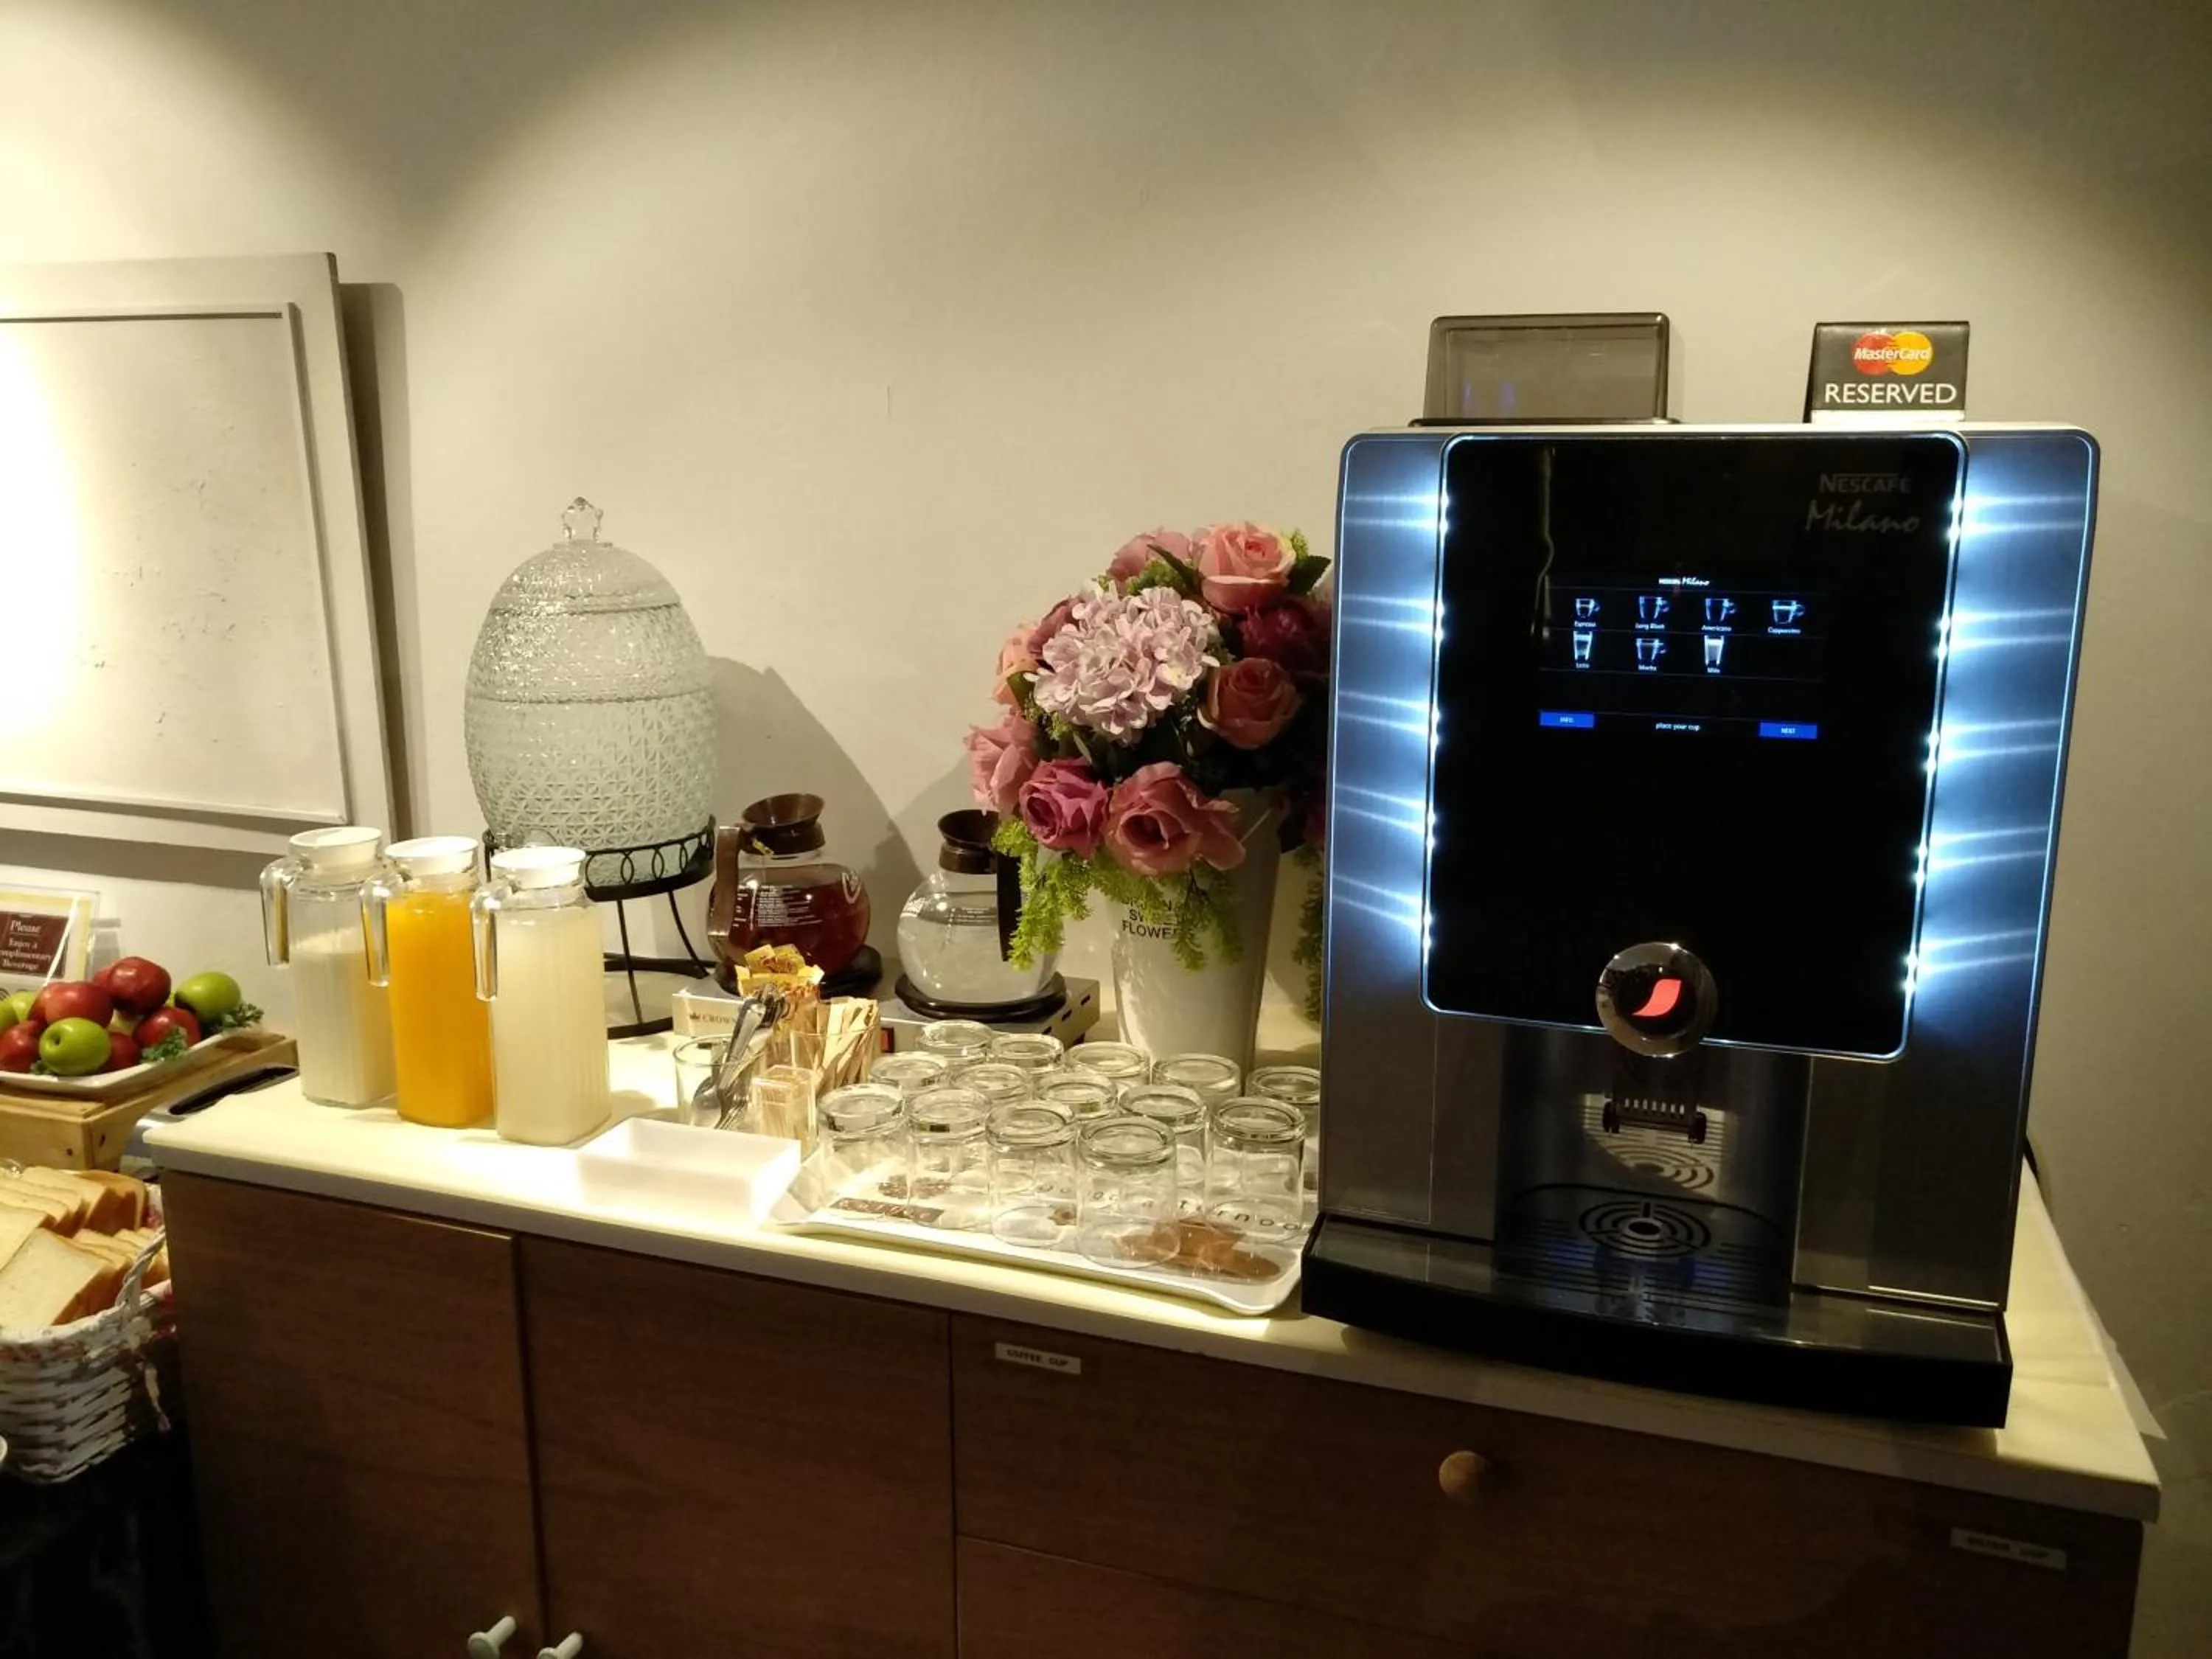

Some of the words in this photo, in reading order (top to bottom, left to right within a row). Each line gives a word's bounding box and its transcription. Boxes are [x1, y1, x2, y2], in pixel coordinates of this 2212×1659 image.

[1854, 347, 1932, 361] MasterCard
[1825, 383, 1957, 404] RESERVED
[1805, 498, 1920, 534] Milano
[10, 919, 41, 933] Please
[9, 937, 30, 949] Enjoy
